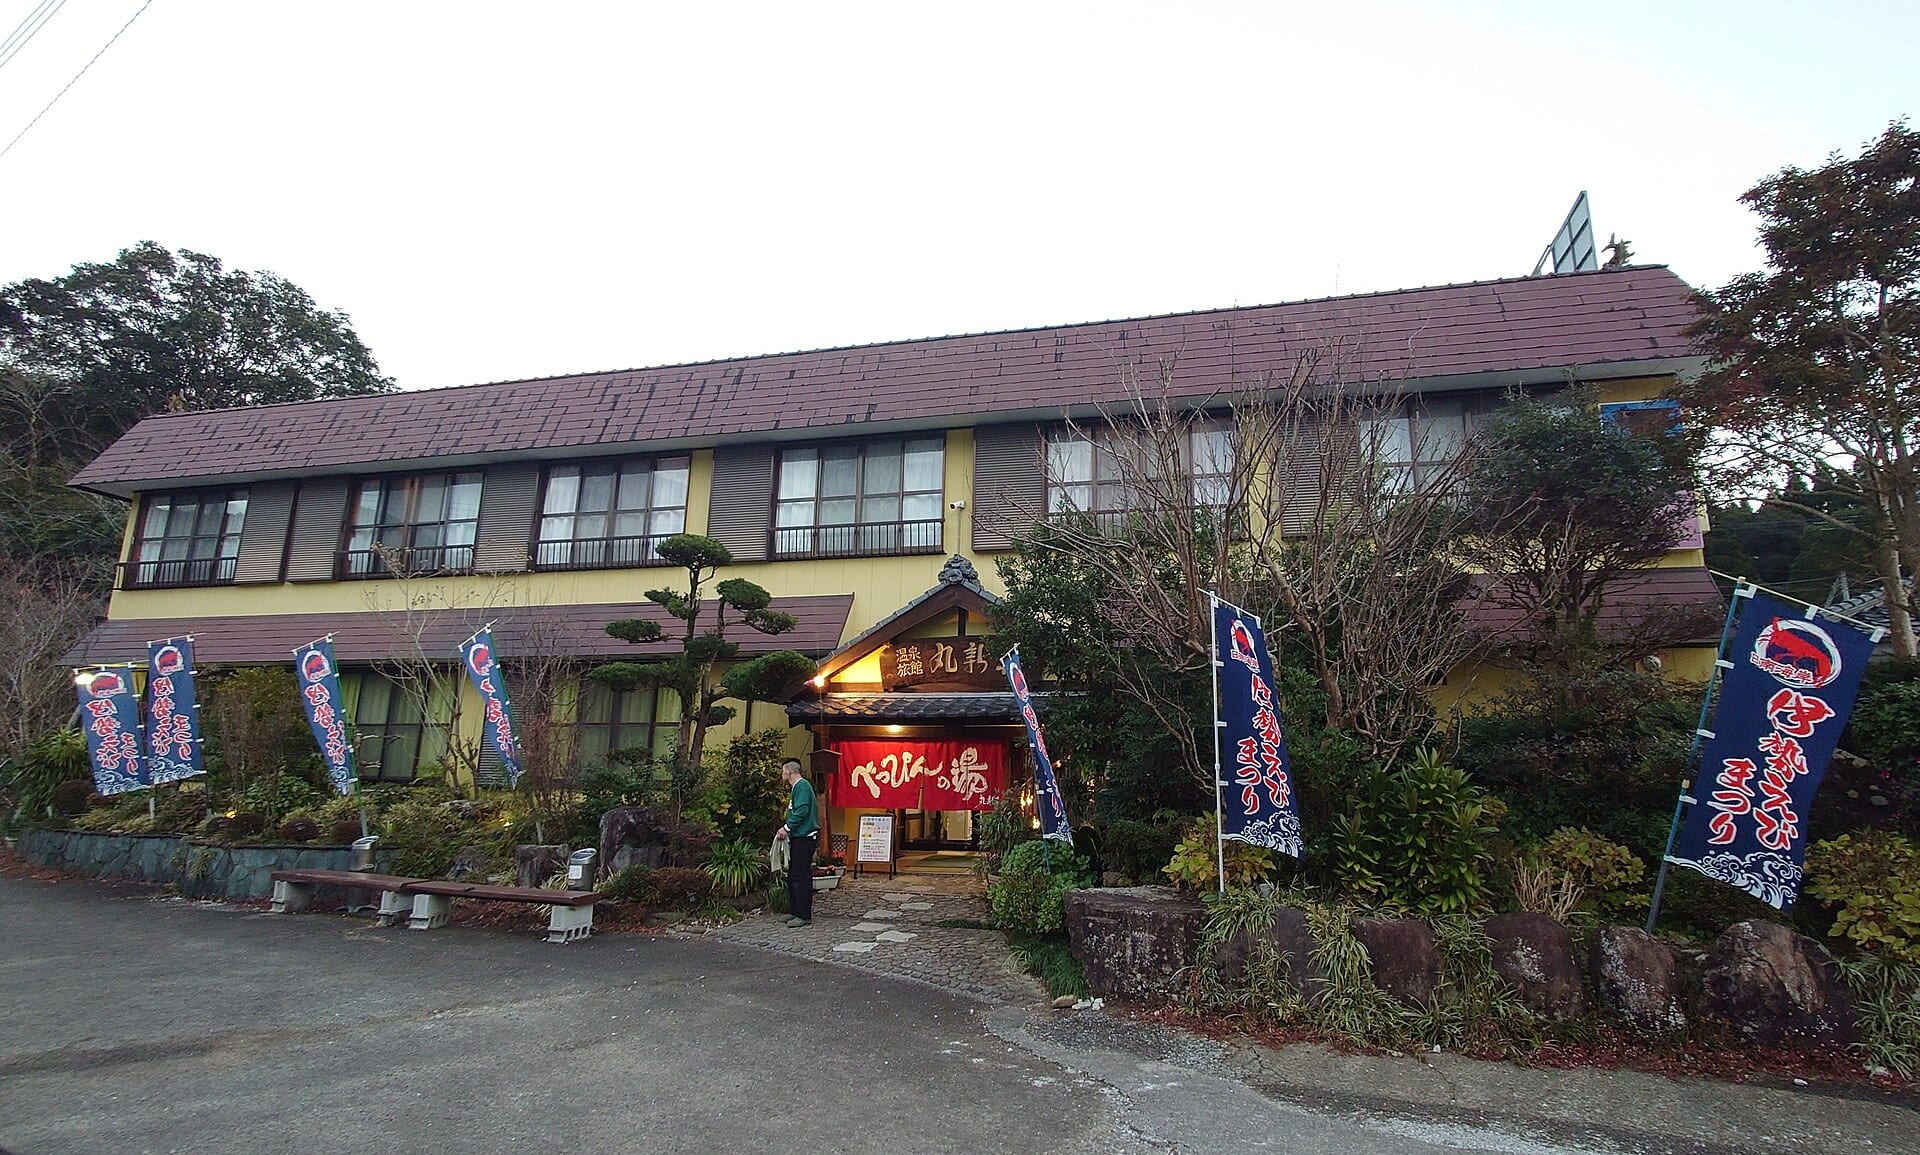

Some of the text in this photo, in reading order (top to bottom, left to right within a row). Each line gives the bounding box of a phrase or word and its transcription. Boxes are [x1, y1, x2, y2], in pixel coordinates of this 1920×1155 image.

[896, 646, 921, 662] 温泉
[897, 661, 924, 677] 旅館
[930, 642, 1006, 675] 丸新
[1750, 651, 1814, 684] 日南海岸
[1252, 673, 1290, 807] 伊勢えび
[852, 747, 988, 800] べっぴんの湯
[1235, 737, 1262, 815] まつり
[1754, 688, 1836, 851] 伊勢えび
[1708, 758, 1756, 845] まつり
